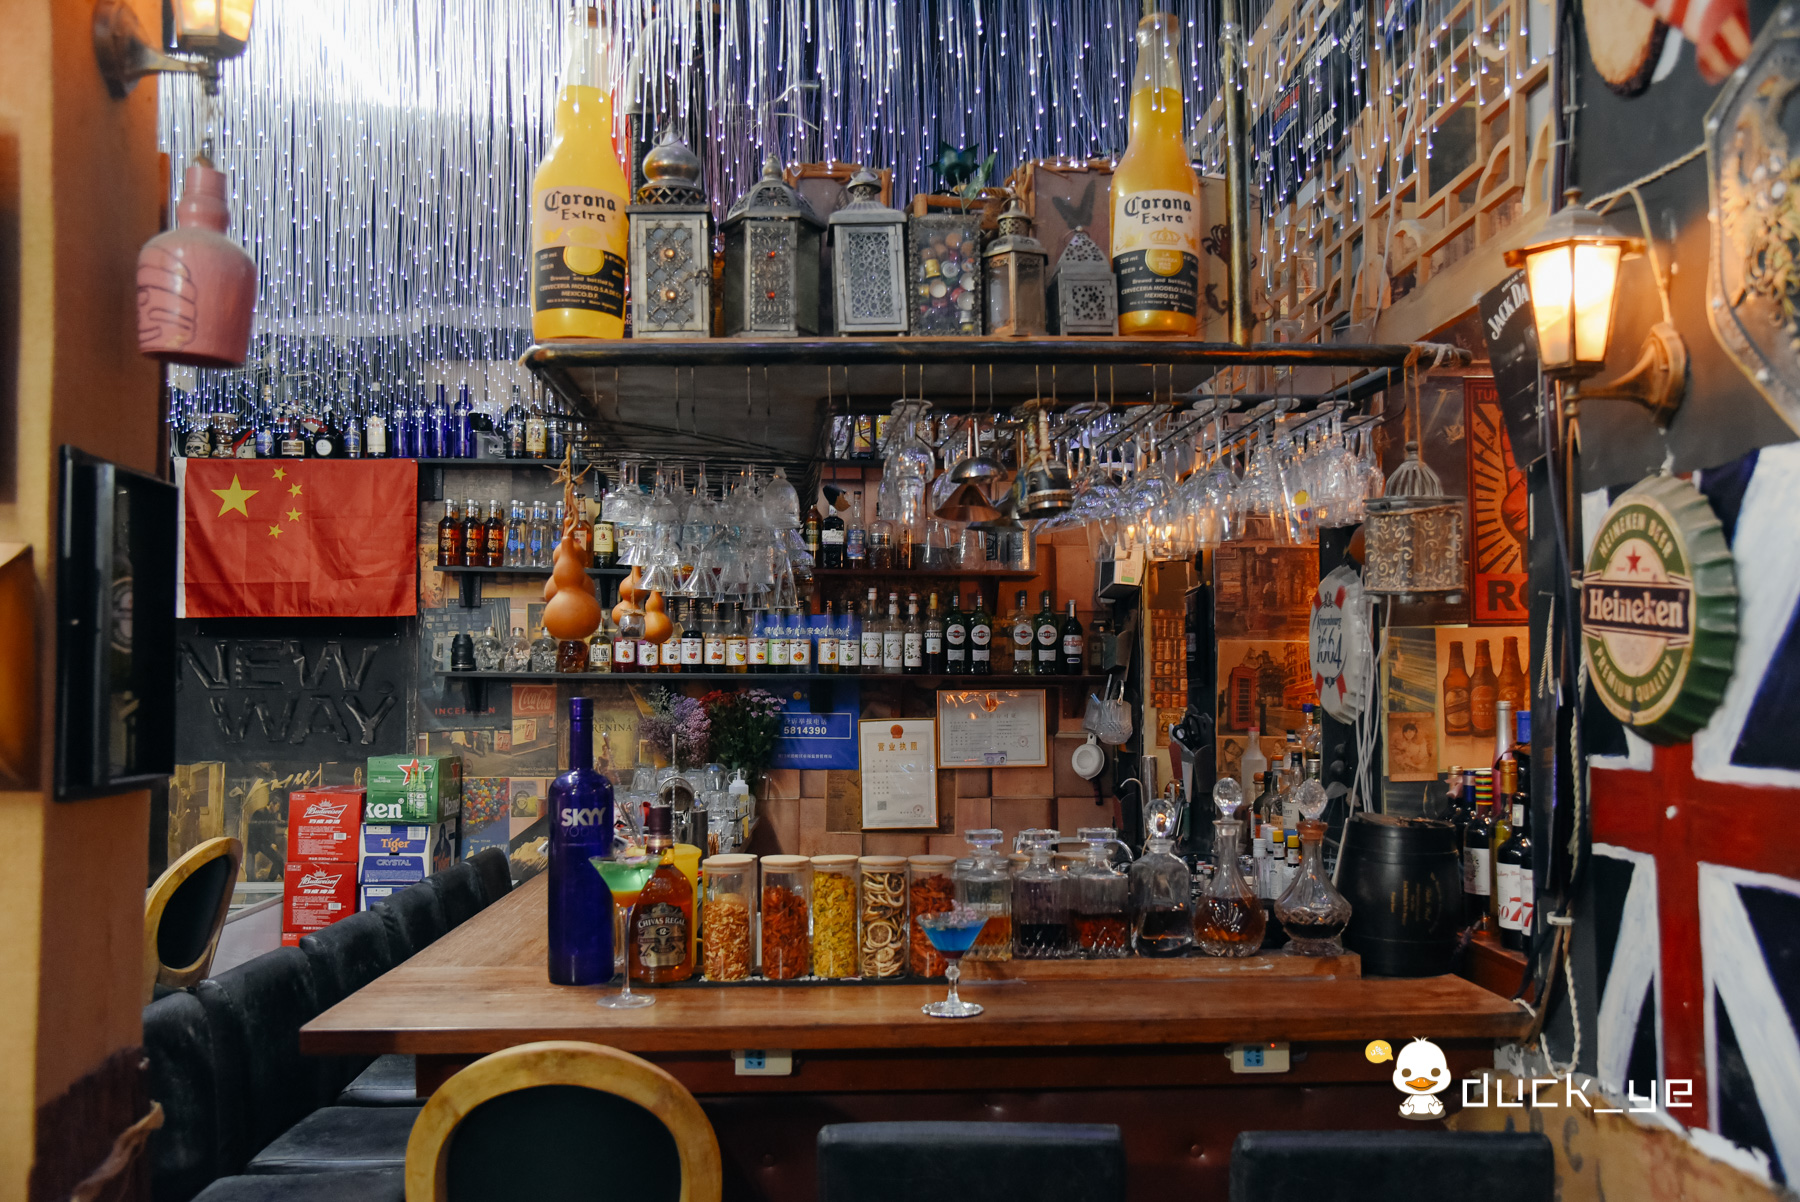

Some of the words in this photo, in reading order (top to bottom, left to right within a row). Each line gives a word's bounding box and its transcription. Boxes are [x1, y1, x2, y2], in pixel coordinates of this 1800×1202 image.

[545, 190, 617, 212] Corona
[1124, 196, 1192, 217] Corona
[561, 208, 606, 223] Extra
[1142, 211, 1183, 225] Extra
[1487, 296, 1516, 341] JACK
[1598, 512, 1647, 559] HEINEKEN
[1648, 518, 1675, 560] BEER
[1588, 587, 1685, 629] Heineken
[1593, 646, 1633, 703] PREMIUM
[1635, 654, 1676, 703] QUALITY
[783, 726, 828, 735] 5814390
[877, 742, 918, 752] 营业执照
[306, 807, 343, 815] Budweiser
[366, 802, 404, 819] ken
[560, 807, 607, 828] SKYY
[381, 838, 410, 853] Tiger
[376, 858, 412, 867] CRYSTAL
[301, 876, 338, 885] Budweiser
[637, 916, 665, 928] CHIVAS
[665, 915, 686, 926] REGAL
